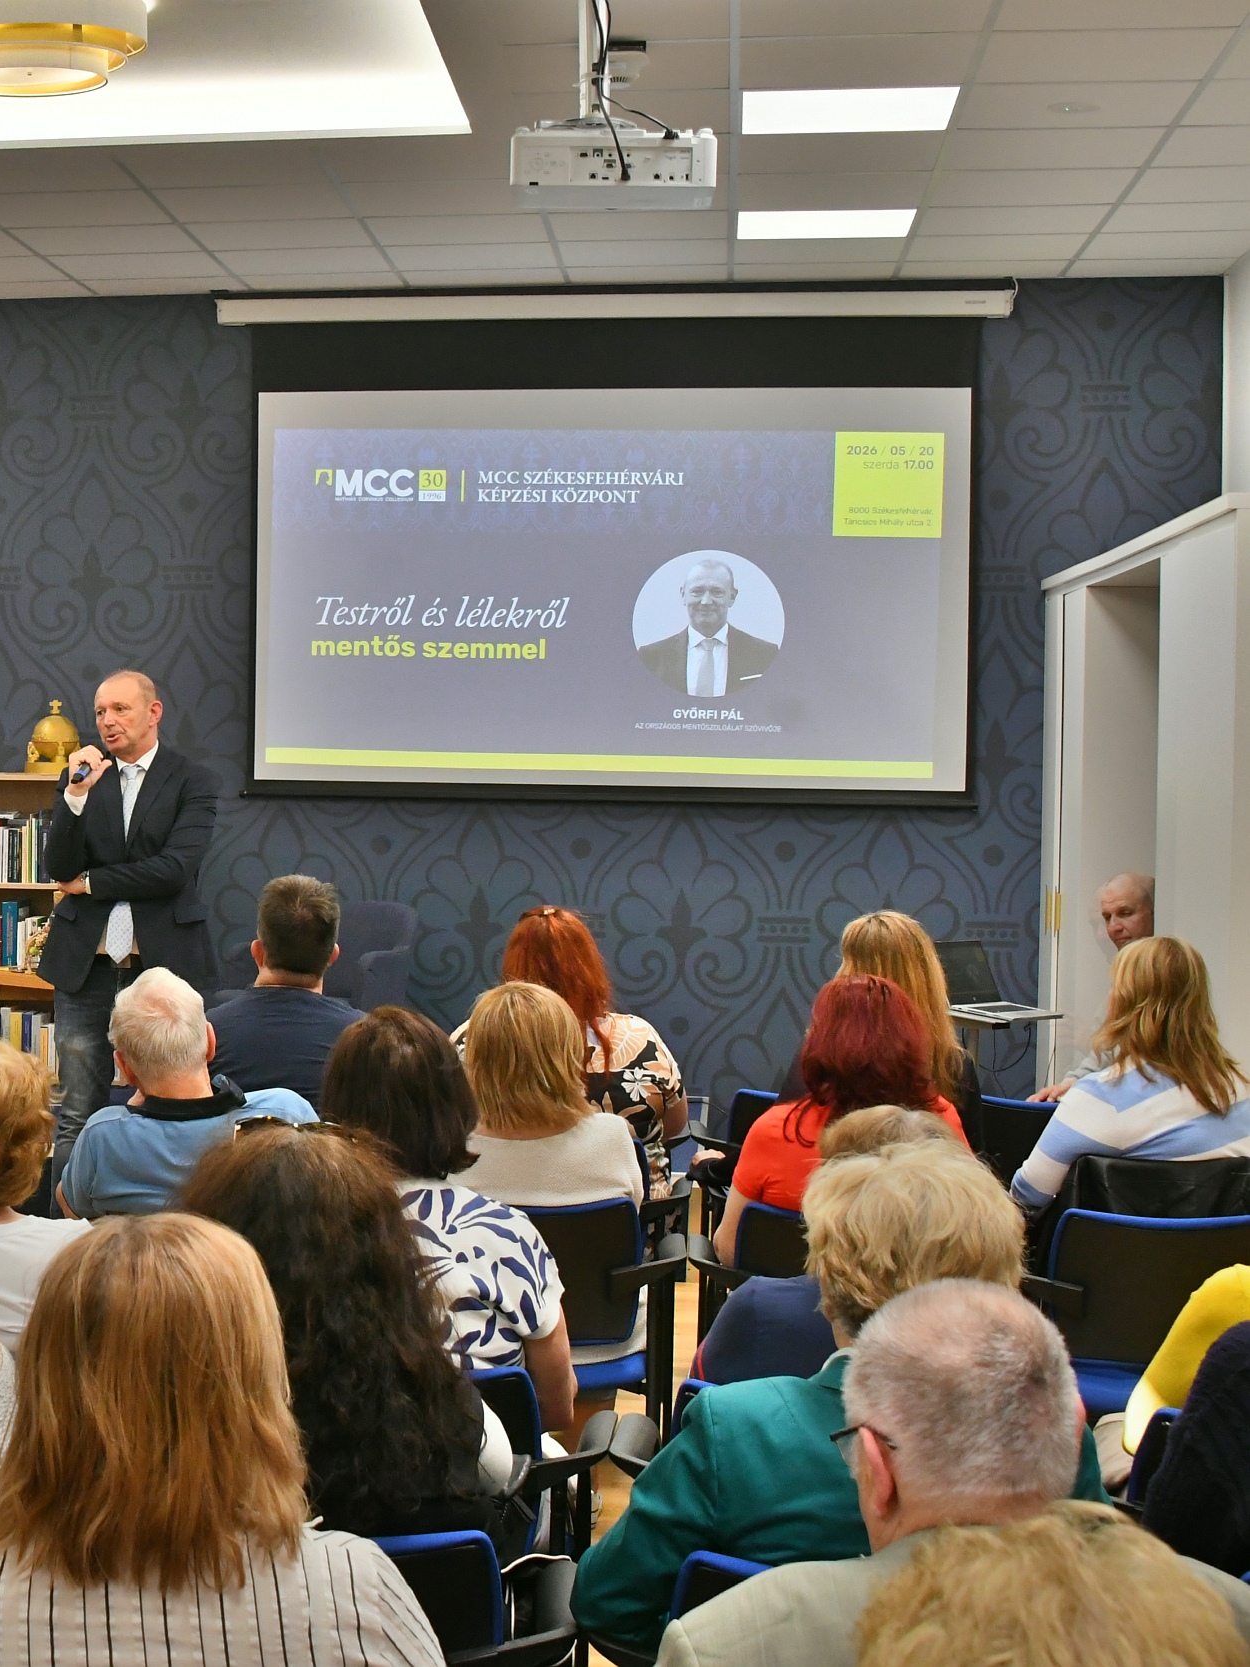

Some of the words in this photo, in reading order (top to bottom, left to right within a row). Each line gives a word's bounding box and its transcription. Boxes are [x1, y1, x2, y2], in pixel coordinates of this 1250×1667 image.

[846, 445, 878, 456] 2026
[890, 445, 906, 456] 05
[919, 446, 934, 456] 20
[863, 460, 899, 470] szerda
[903, 460, 934, 470] 17.00
[335, 468, 415, 497] MCC
[421, 472, 443, 488] 30
[478, 470, 520, 485] MCC
[523, 468, 685, 486] SZÉKESFEHÉRVÁRI
[422, 492, 442, 500] 1996
[478, 487, 548, 503] KÉPZÉSI
[551, 487, 640, 504] KÖZPONT
[315, 594, 416, 627] Testről
[421, 597, 448, 627] és
[454, 595, 570, 629] lélekről
[311, 634, 416, 657] mentős
[422, 638, 547, 660] szemmel
[672, 707, 718, 720] GYŐRFI
[720, 708, 745, 721] PÁL
[645, 721, 681, 730] ORSZÁGOS
